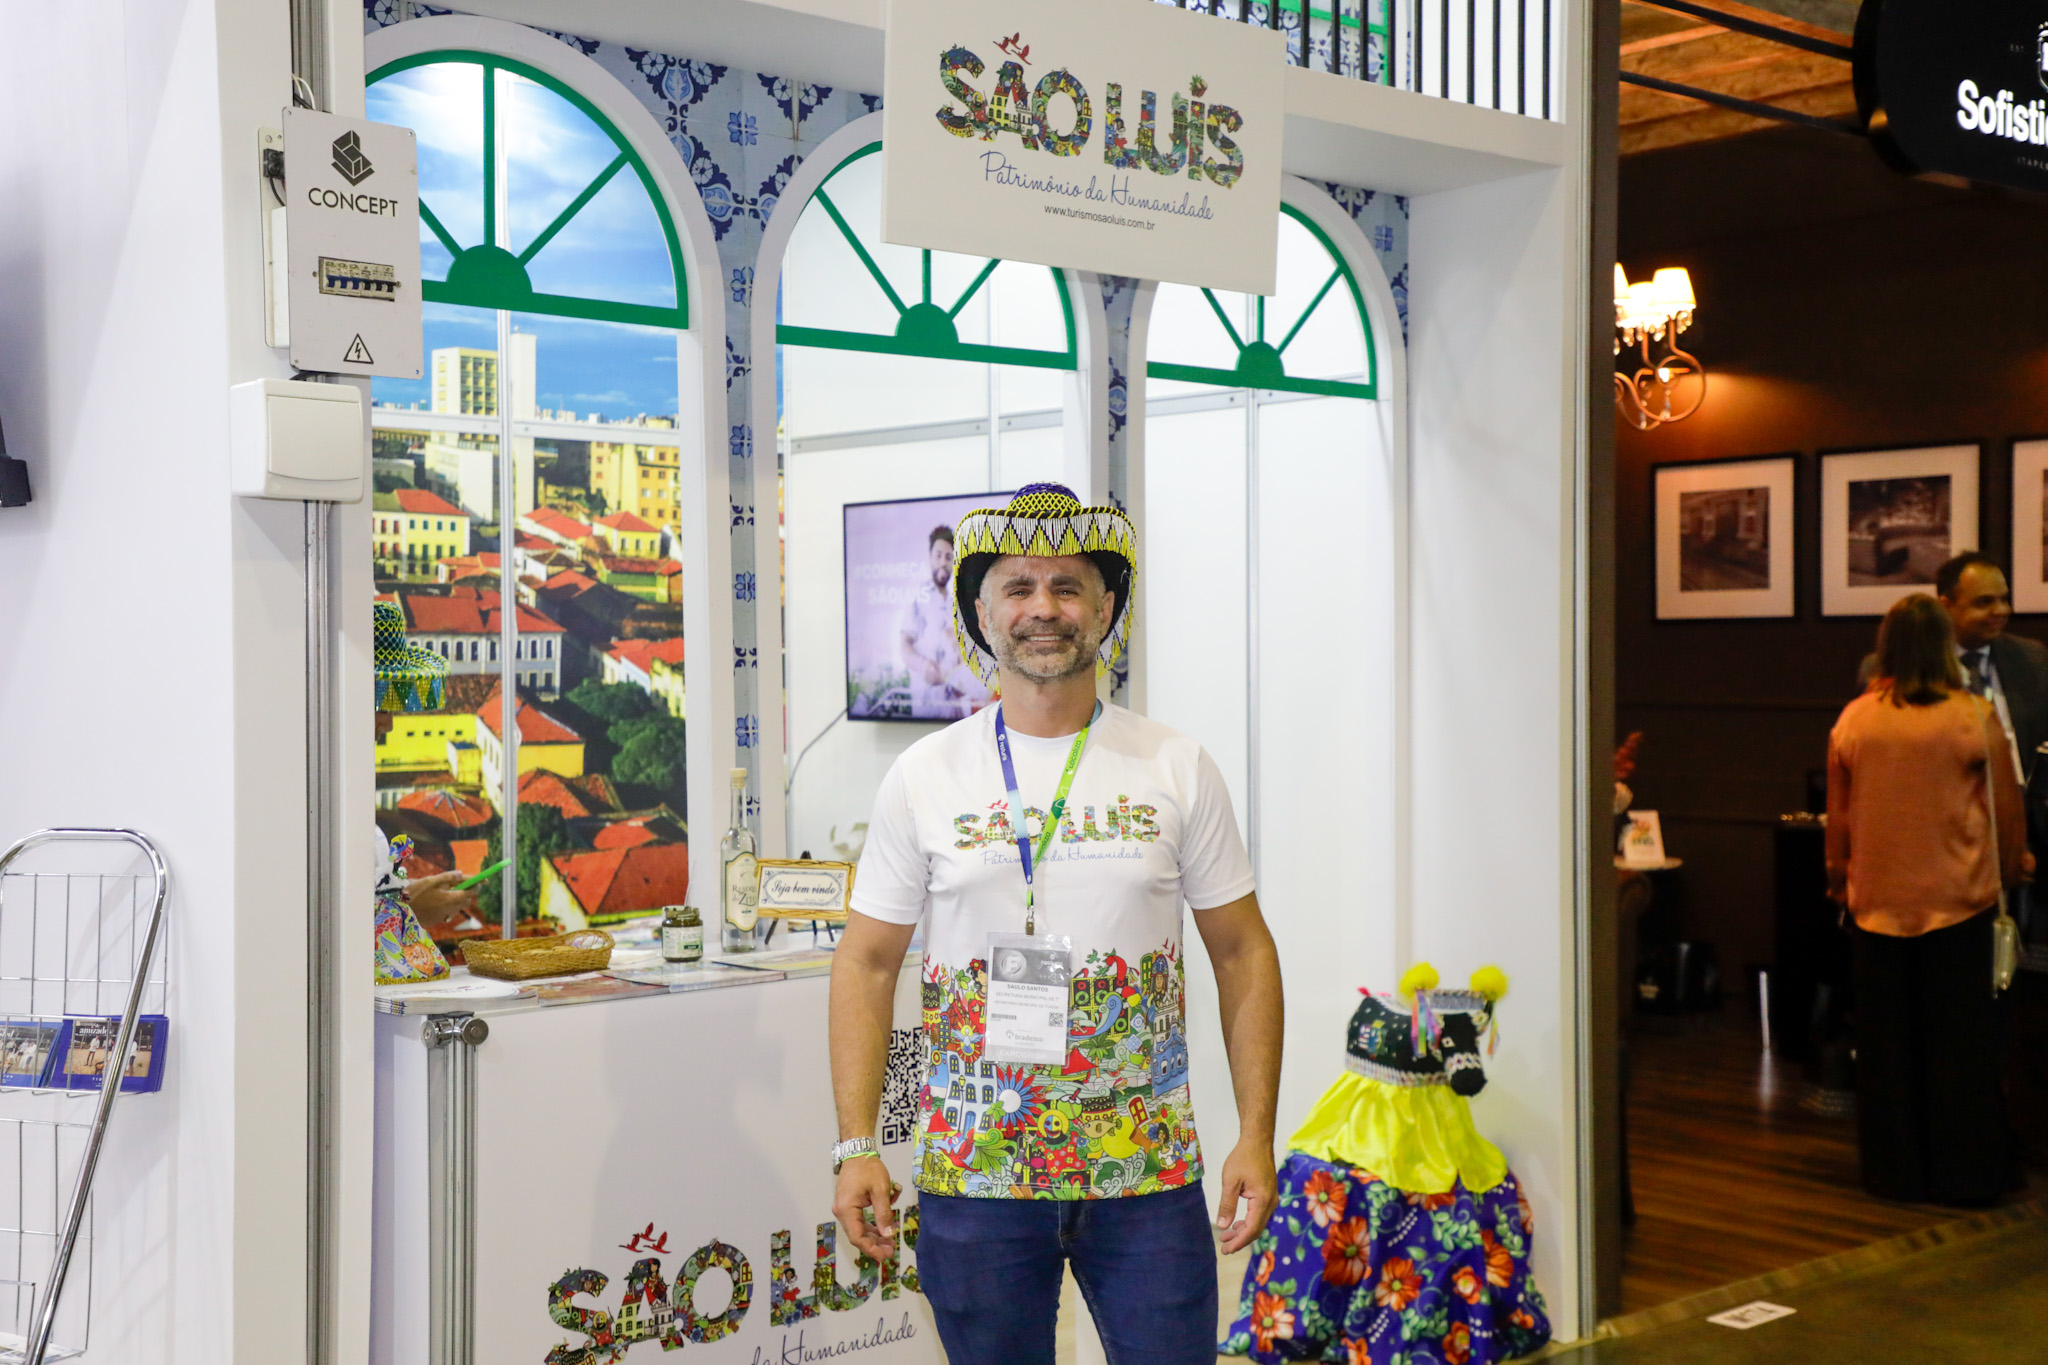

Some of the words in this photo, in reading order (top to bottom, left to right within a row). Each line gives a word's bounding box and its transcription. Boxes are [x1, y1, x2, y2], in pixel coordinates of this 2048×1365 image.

[979, 150, 1083, 200] Patrimônio
[1084, 175, 1107, 202] da
[1109, 175, 1214, 219] Humanidade
[308, 187, 398, 217] CONCEPT
[1044, 204, 1155, 230] www.turismosaoluis.com.br
[1049, 849, 1066, 862] da
[1067, 846, 1144, 861] Humanidade
[771, 879, 791, 898] Seja
[792, 881, 809, 894] bem
[811, 882, 836, 895] vindo
[1026, 985, 1049, 993] SANTOS
[1015, 1034, 1044, 1042] bradesco
[782, 1312, 917, 1365] Humanidade
